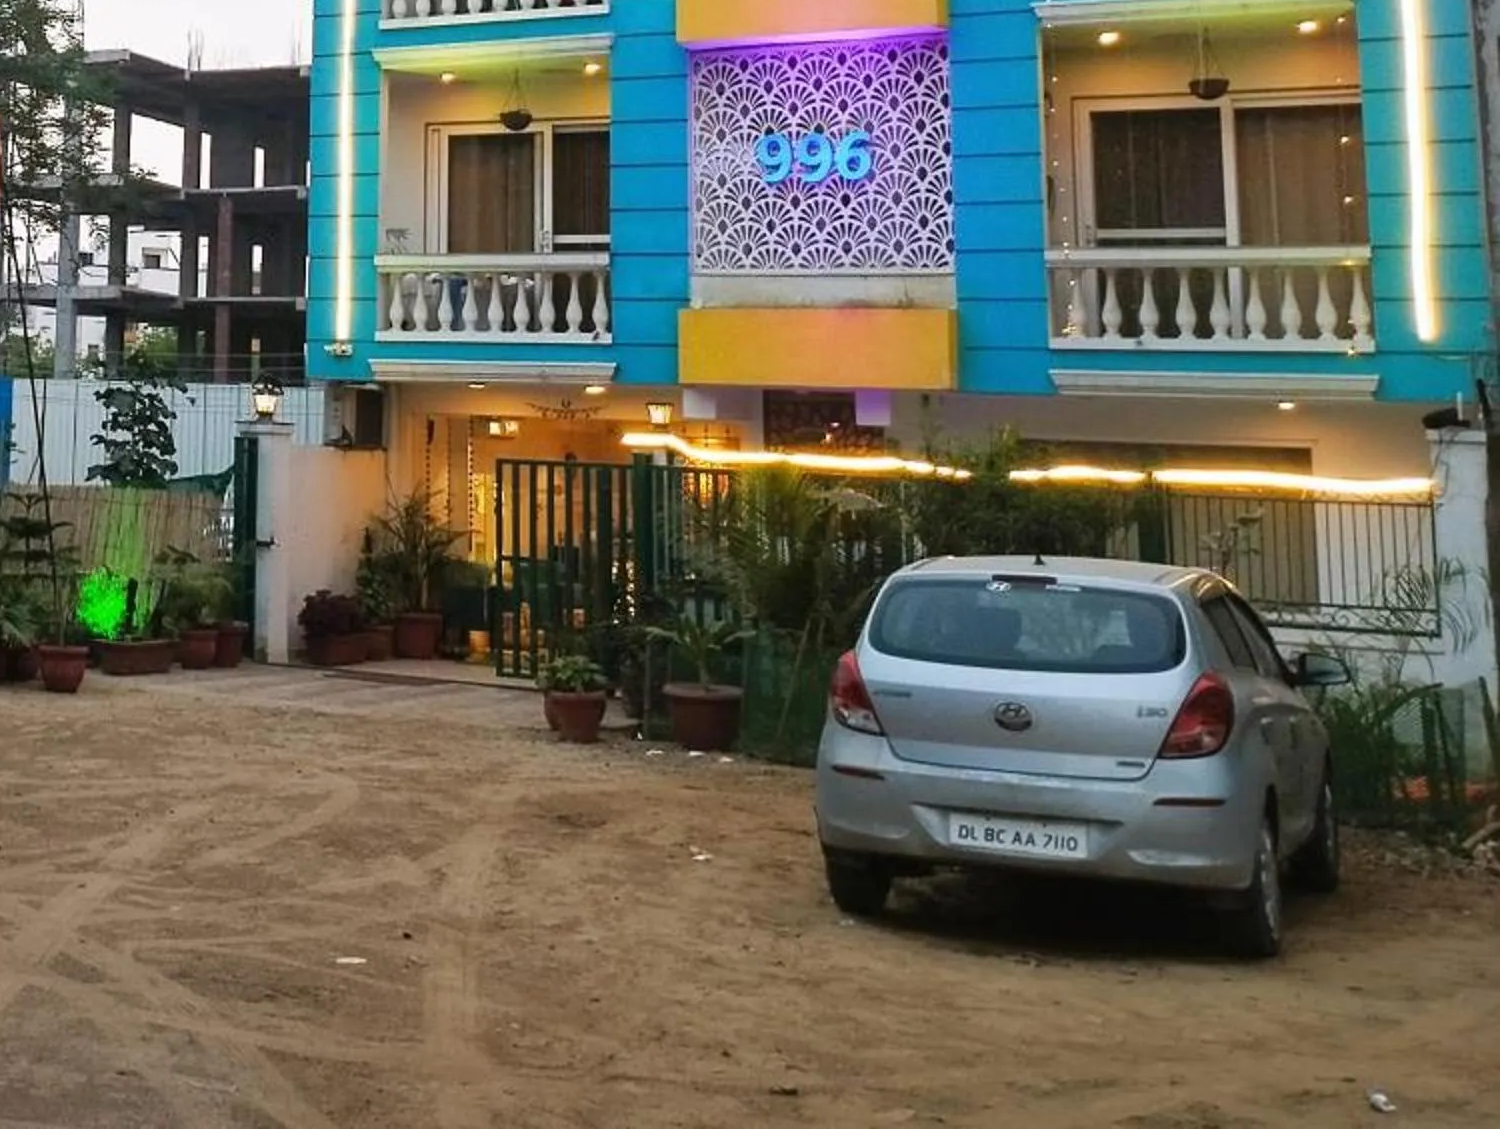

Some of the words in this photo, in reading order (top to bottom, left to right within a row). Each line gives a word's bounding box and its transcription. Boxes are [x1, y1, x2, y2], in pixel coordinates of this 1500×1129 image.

[755, 131, 873, 184] 996
[957, 824, 978, 841] DL
[1011, 831, 1036, 847] AA
[1042, 833, 1079, 852] 7110
